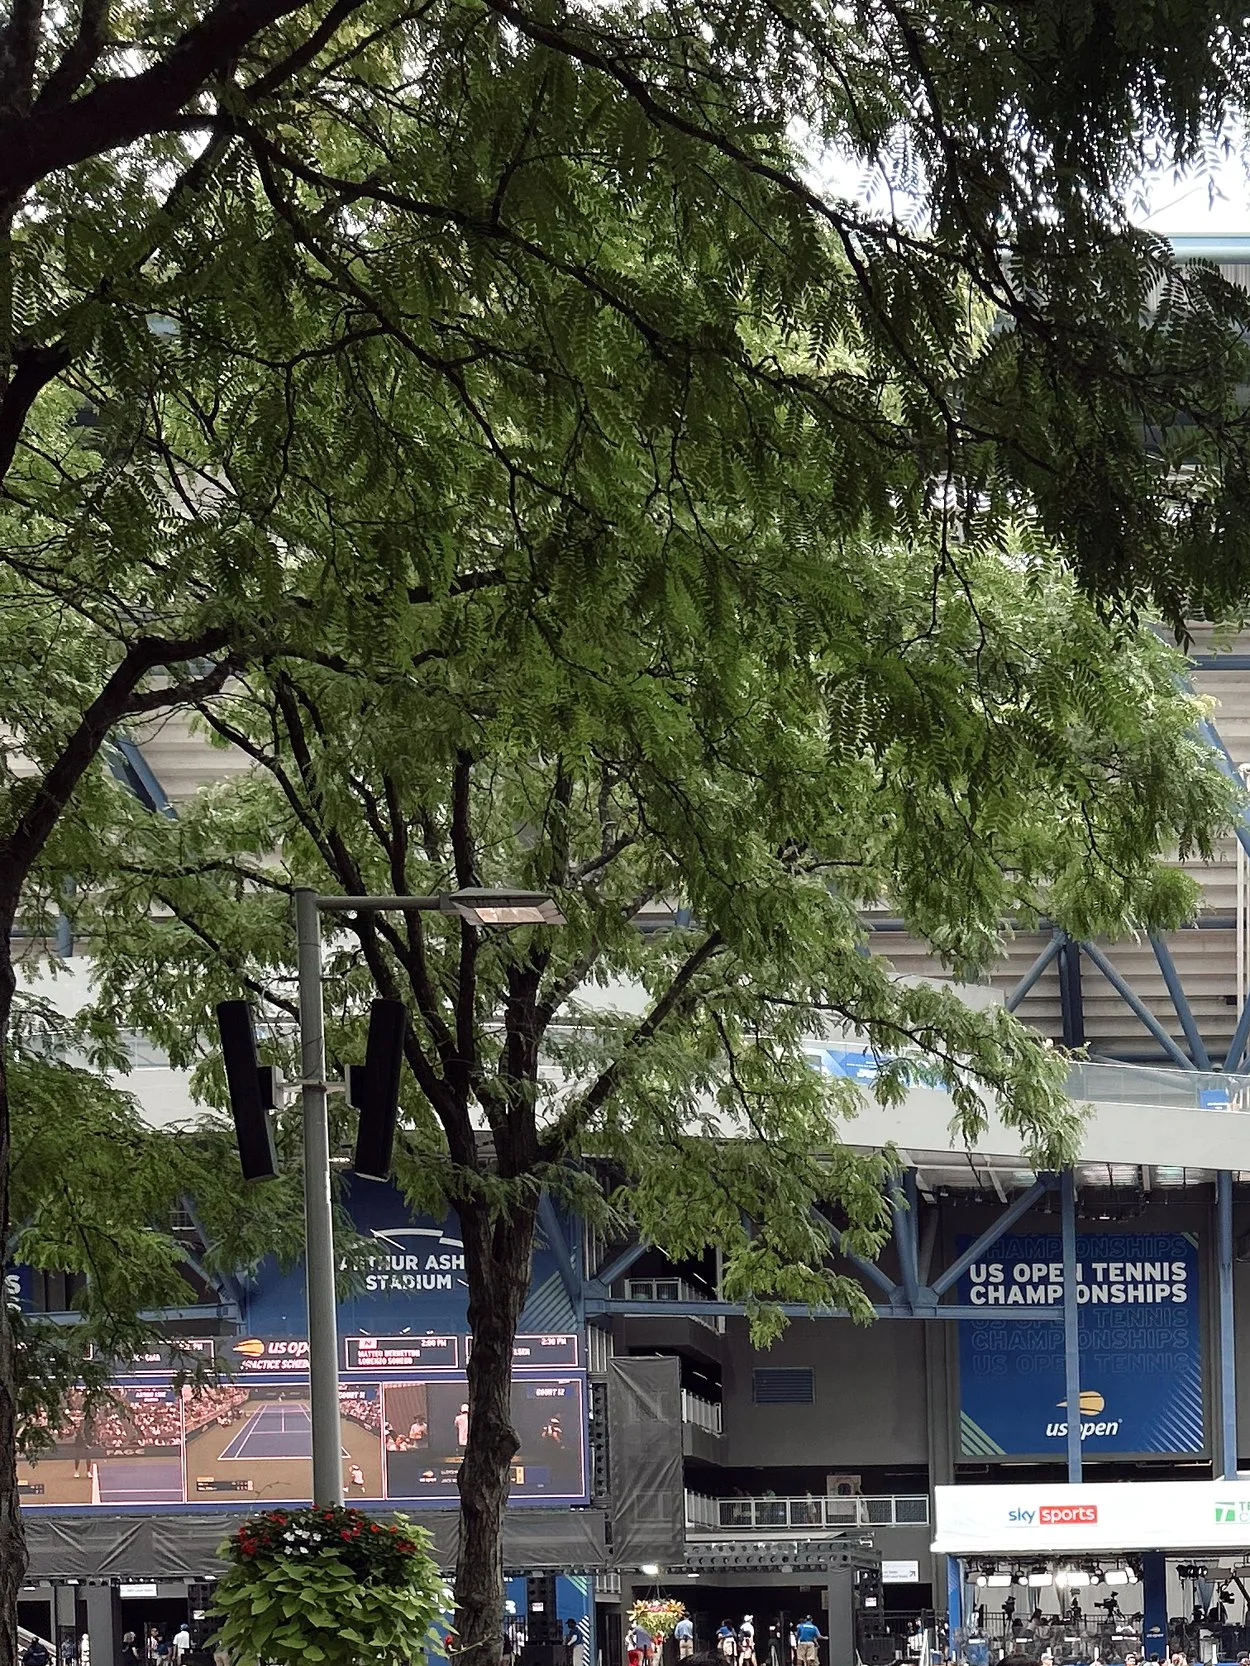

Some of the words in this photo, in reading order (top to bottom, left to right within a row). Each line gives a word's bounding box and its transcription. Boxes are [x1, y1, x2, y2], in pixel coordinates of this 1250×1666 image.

[980, 1237, 1188, 1260] HAMPONSHIPS
[424, 1255, 465, 1270] ASH
[969, 1264, 1004, 1283] US
[1092, 1262, 1187, 1282] TENNIS
[366, 1274, 452, 1290] STADIUM
[969, 1284, 1188, 1305] CHAMPONSHIPS
[1093, 1307, 1189, 1328] TENNIS
[287, 1342, 309, 1357] op
[971, 1329, 1189, 1352] CHAMPONSHIPS
[281, 1360, 310, 1370] SCHED
[971, 1355, 1007, 1375] US
[1094, 1352, 1190, 1374] TENNIS
[1046, 1423, 1068, 1437] us
[1079, 1421, 1120, 1441] pen
[1008, 1507, 1036, 1524] sky
[1041, 1506, 1095, 1523] sports
